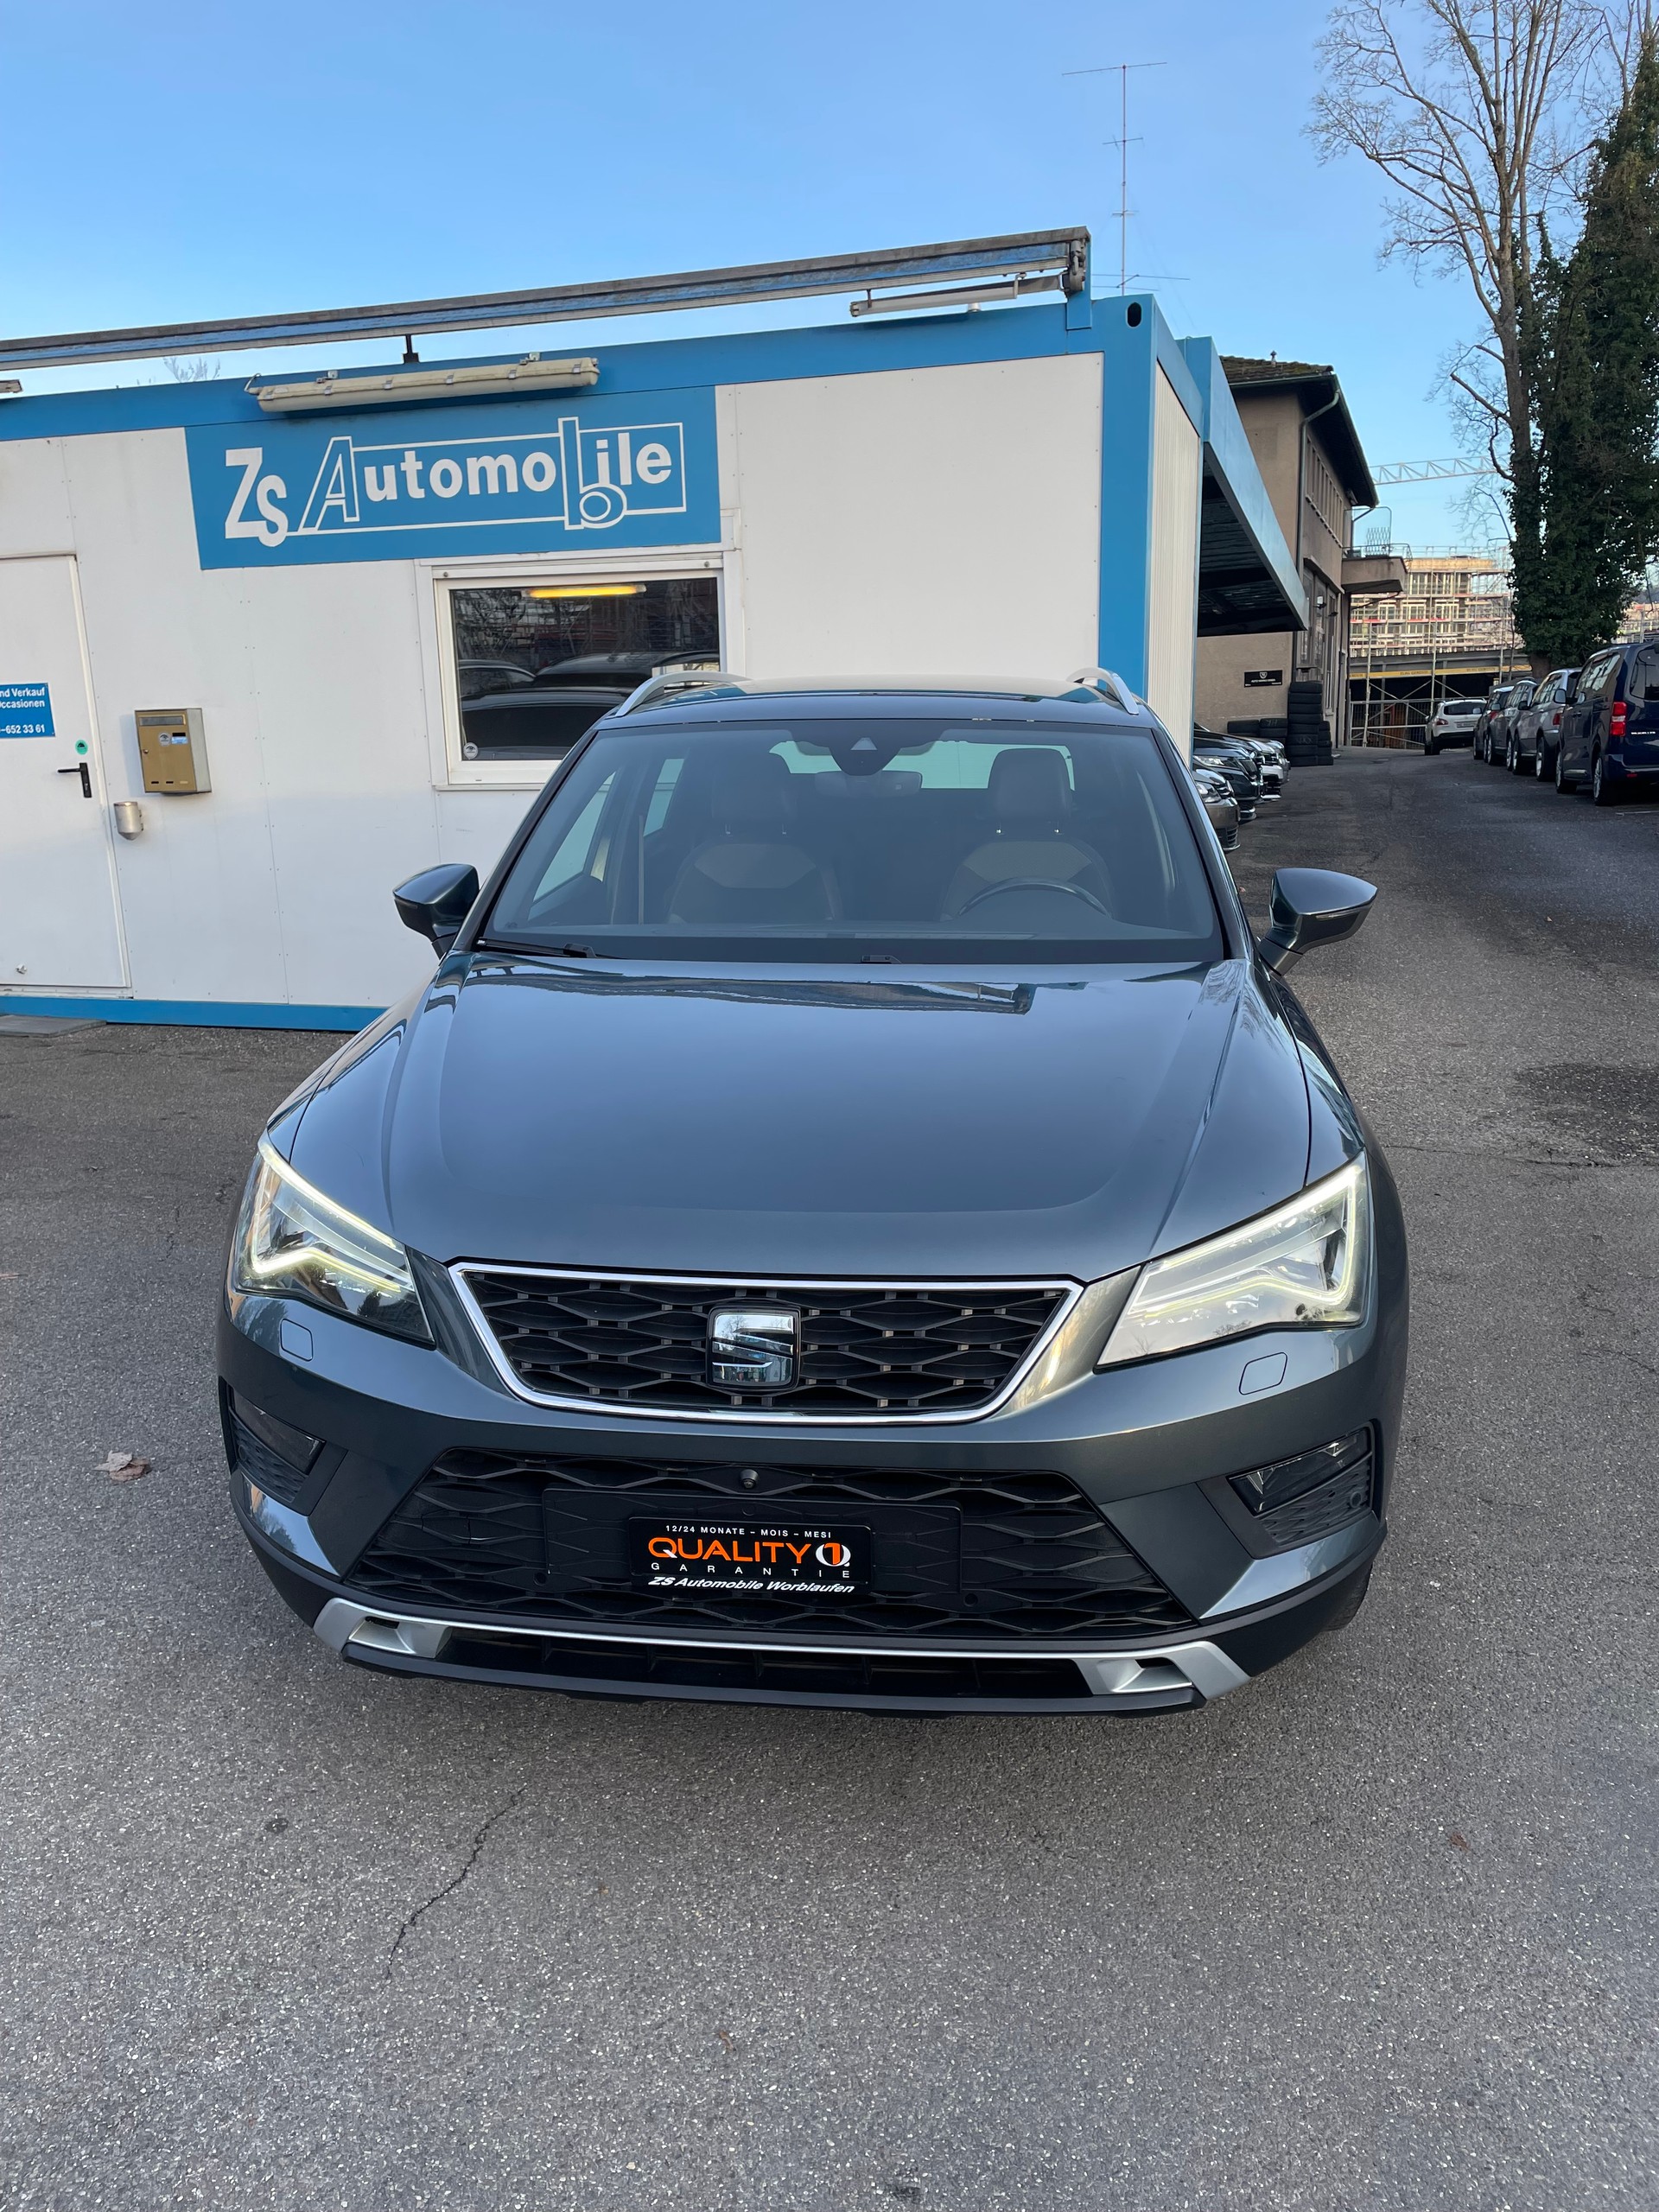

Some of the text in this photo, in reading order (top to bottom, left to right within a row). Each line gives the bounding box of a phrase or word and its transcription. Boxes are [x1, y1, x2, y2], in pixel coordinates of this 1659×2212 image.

[297, 416, 672, 530] Automobile
[11, 687, 45, 696] Verkauf
[0, 699, 45, 709] ccasionen
[22, 724, 34, 734] 33
[35, 723, 45, 733] 61
[701, 1526, 745, 1535] MONATE
[648, 1537, 811, 1564] QUALITY
[651, 1562, 850, 1578] GARANTIE
[648, 1576, 855, 1593] ZS Automobile Worblaufen
